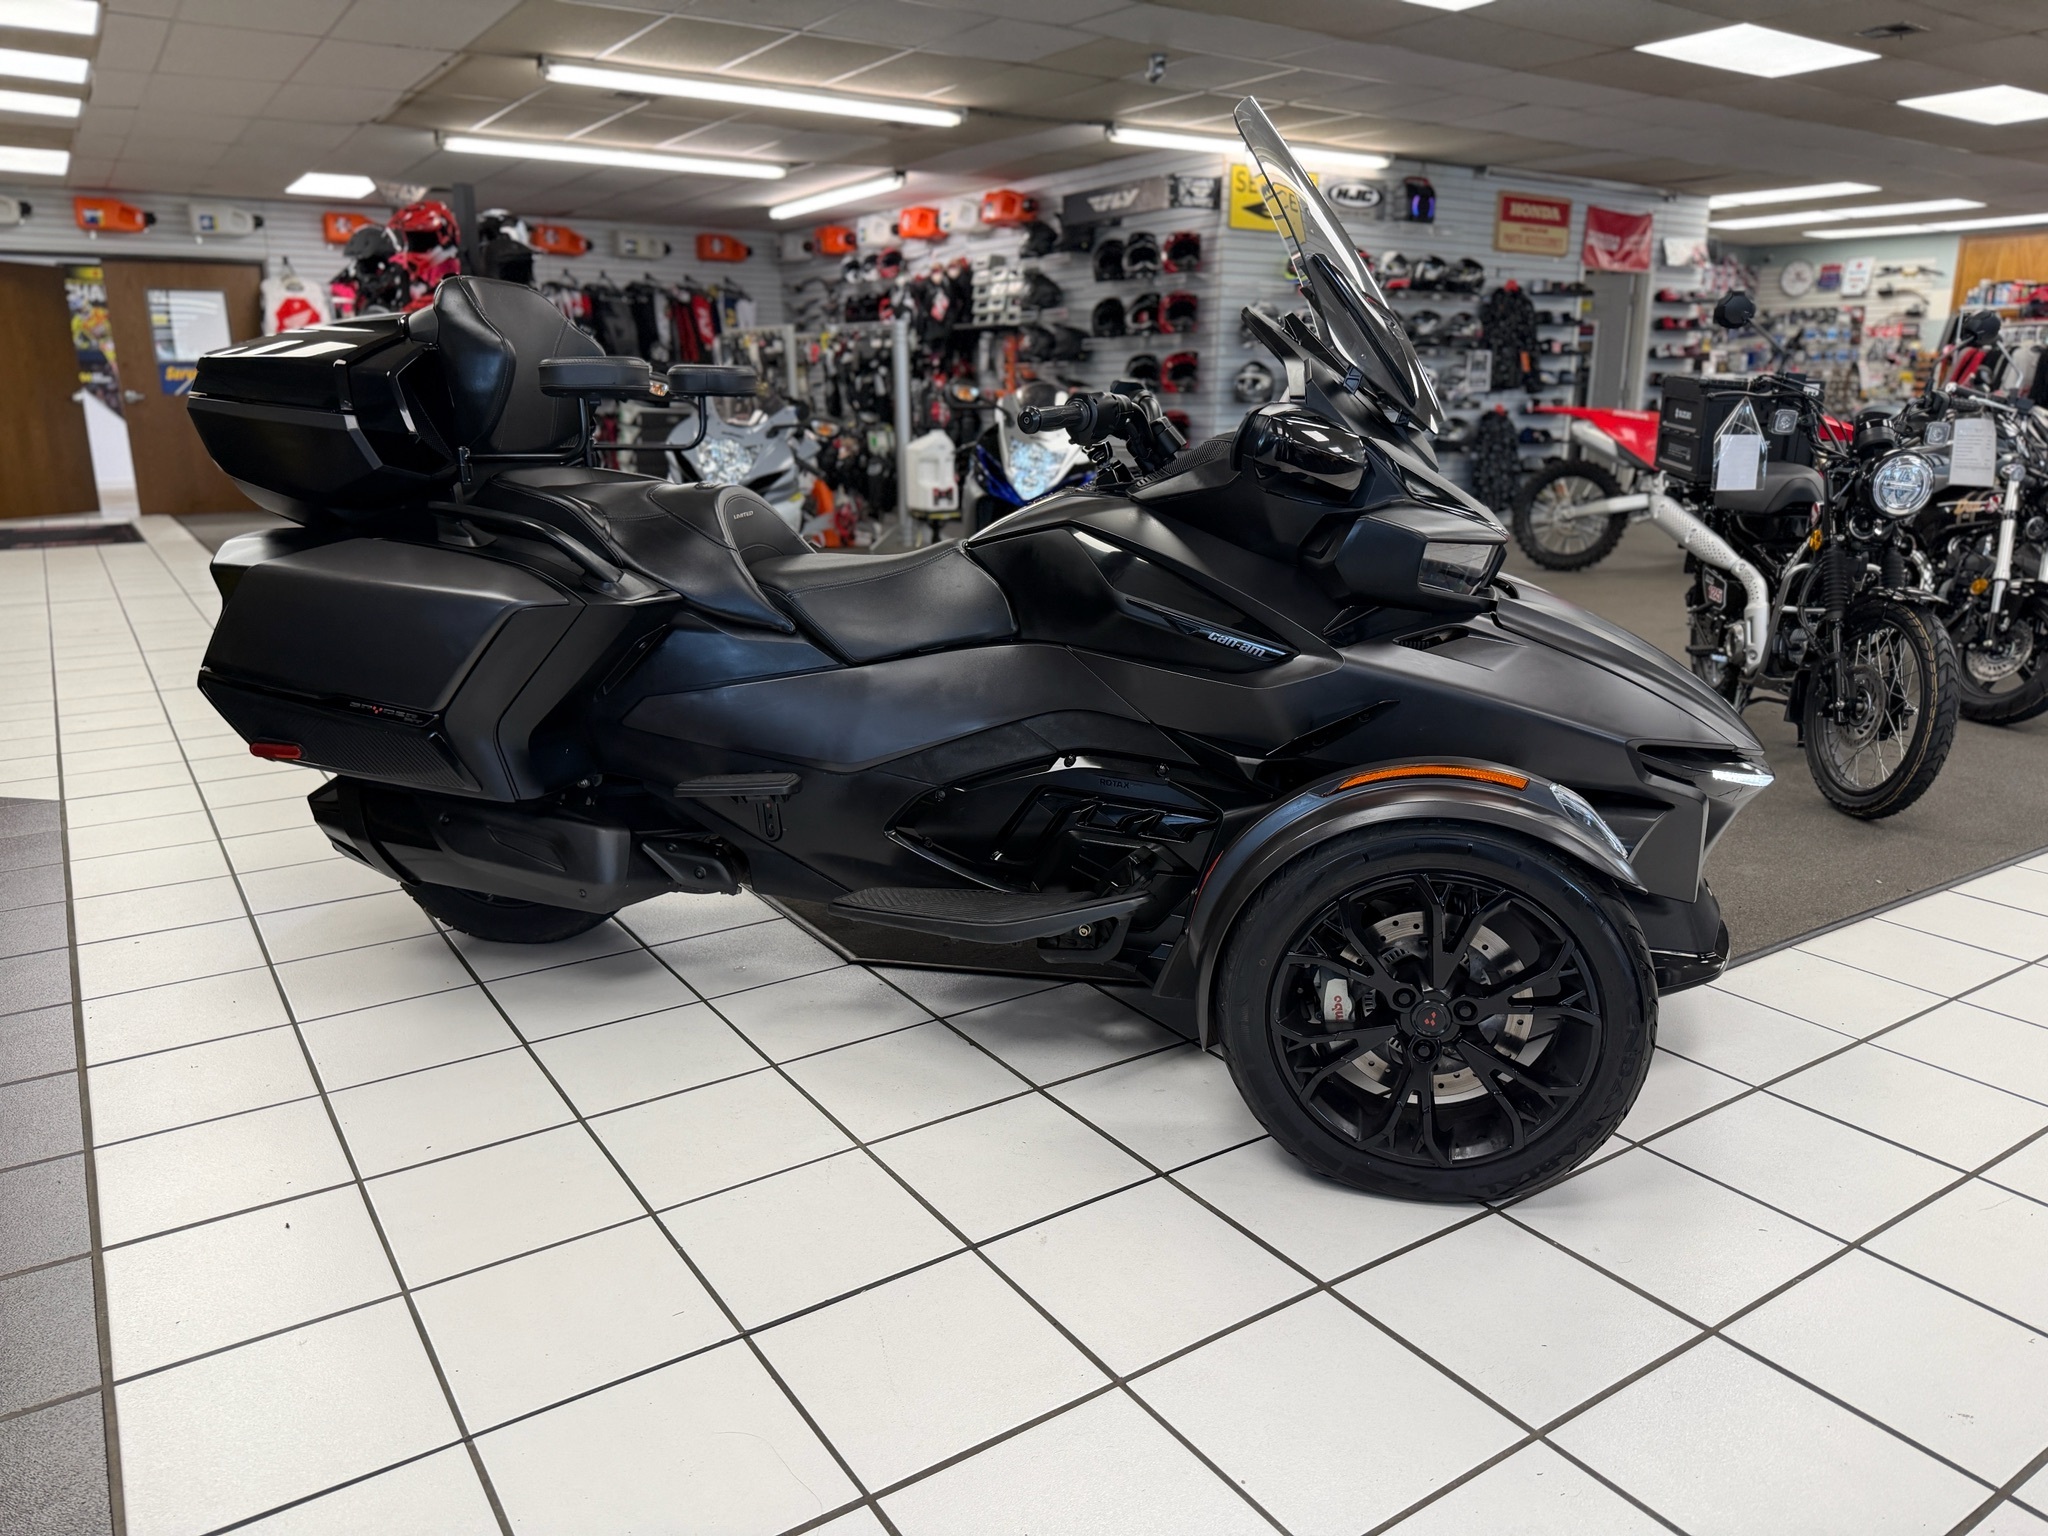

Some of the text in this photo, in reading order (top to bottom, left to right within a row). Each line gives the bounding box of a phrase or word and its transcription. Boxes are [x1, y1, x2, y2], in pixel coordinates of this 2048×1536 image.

[1336, 186, 1373, 201] HJC
[1509, 201, 1561, 221] HONDA
[165, 365, 198, 381] Serv
[733, 510, 754, 520] LIMITED
[1207, 631, 1266, 657] can-am
[1099, 778, 1130, 789] ROTAX
